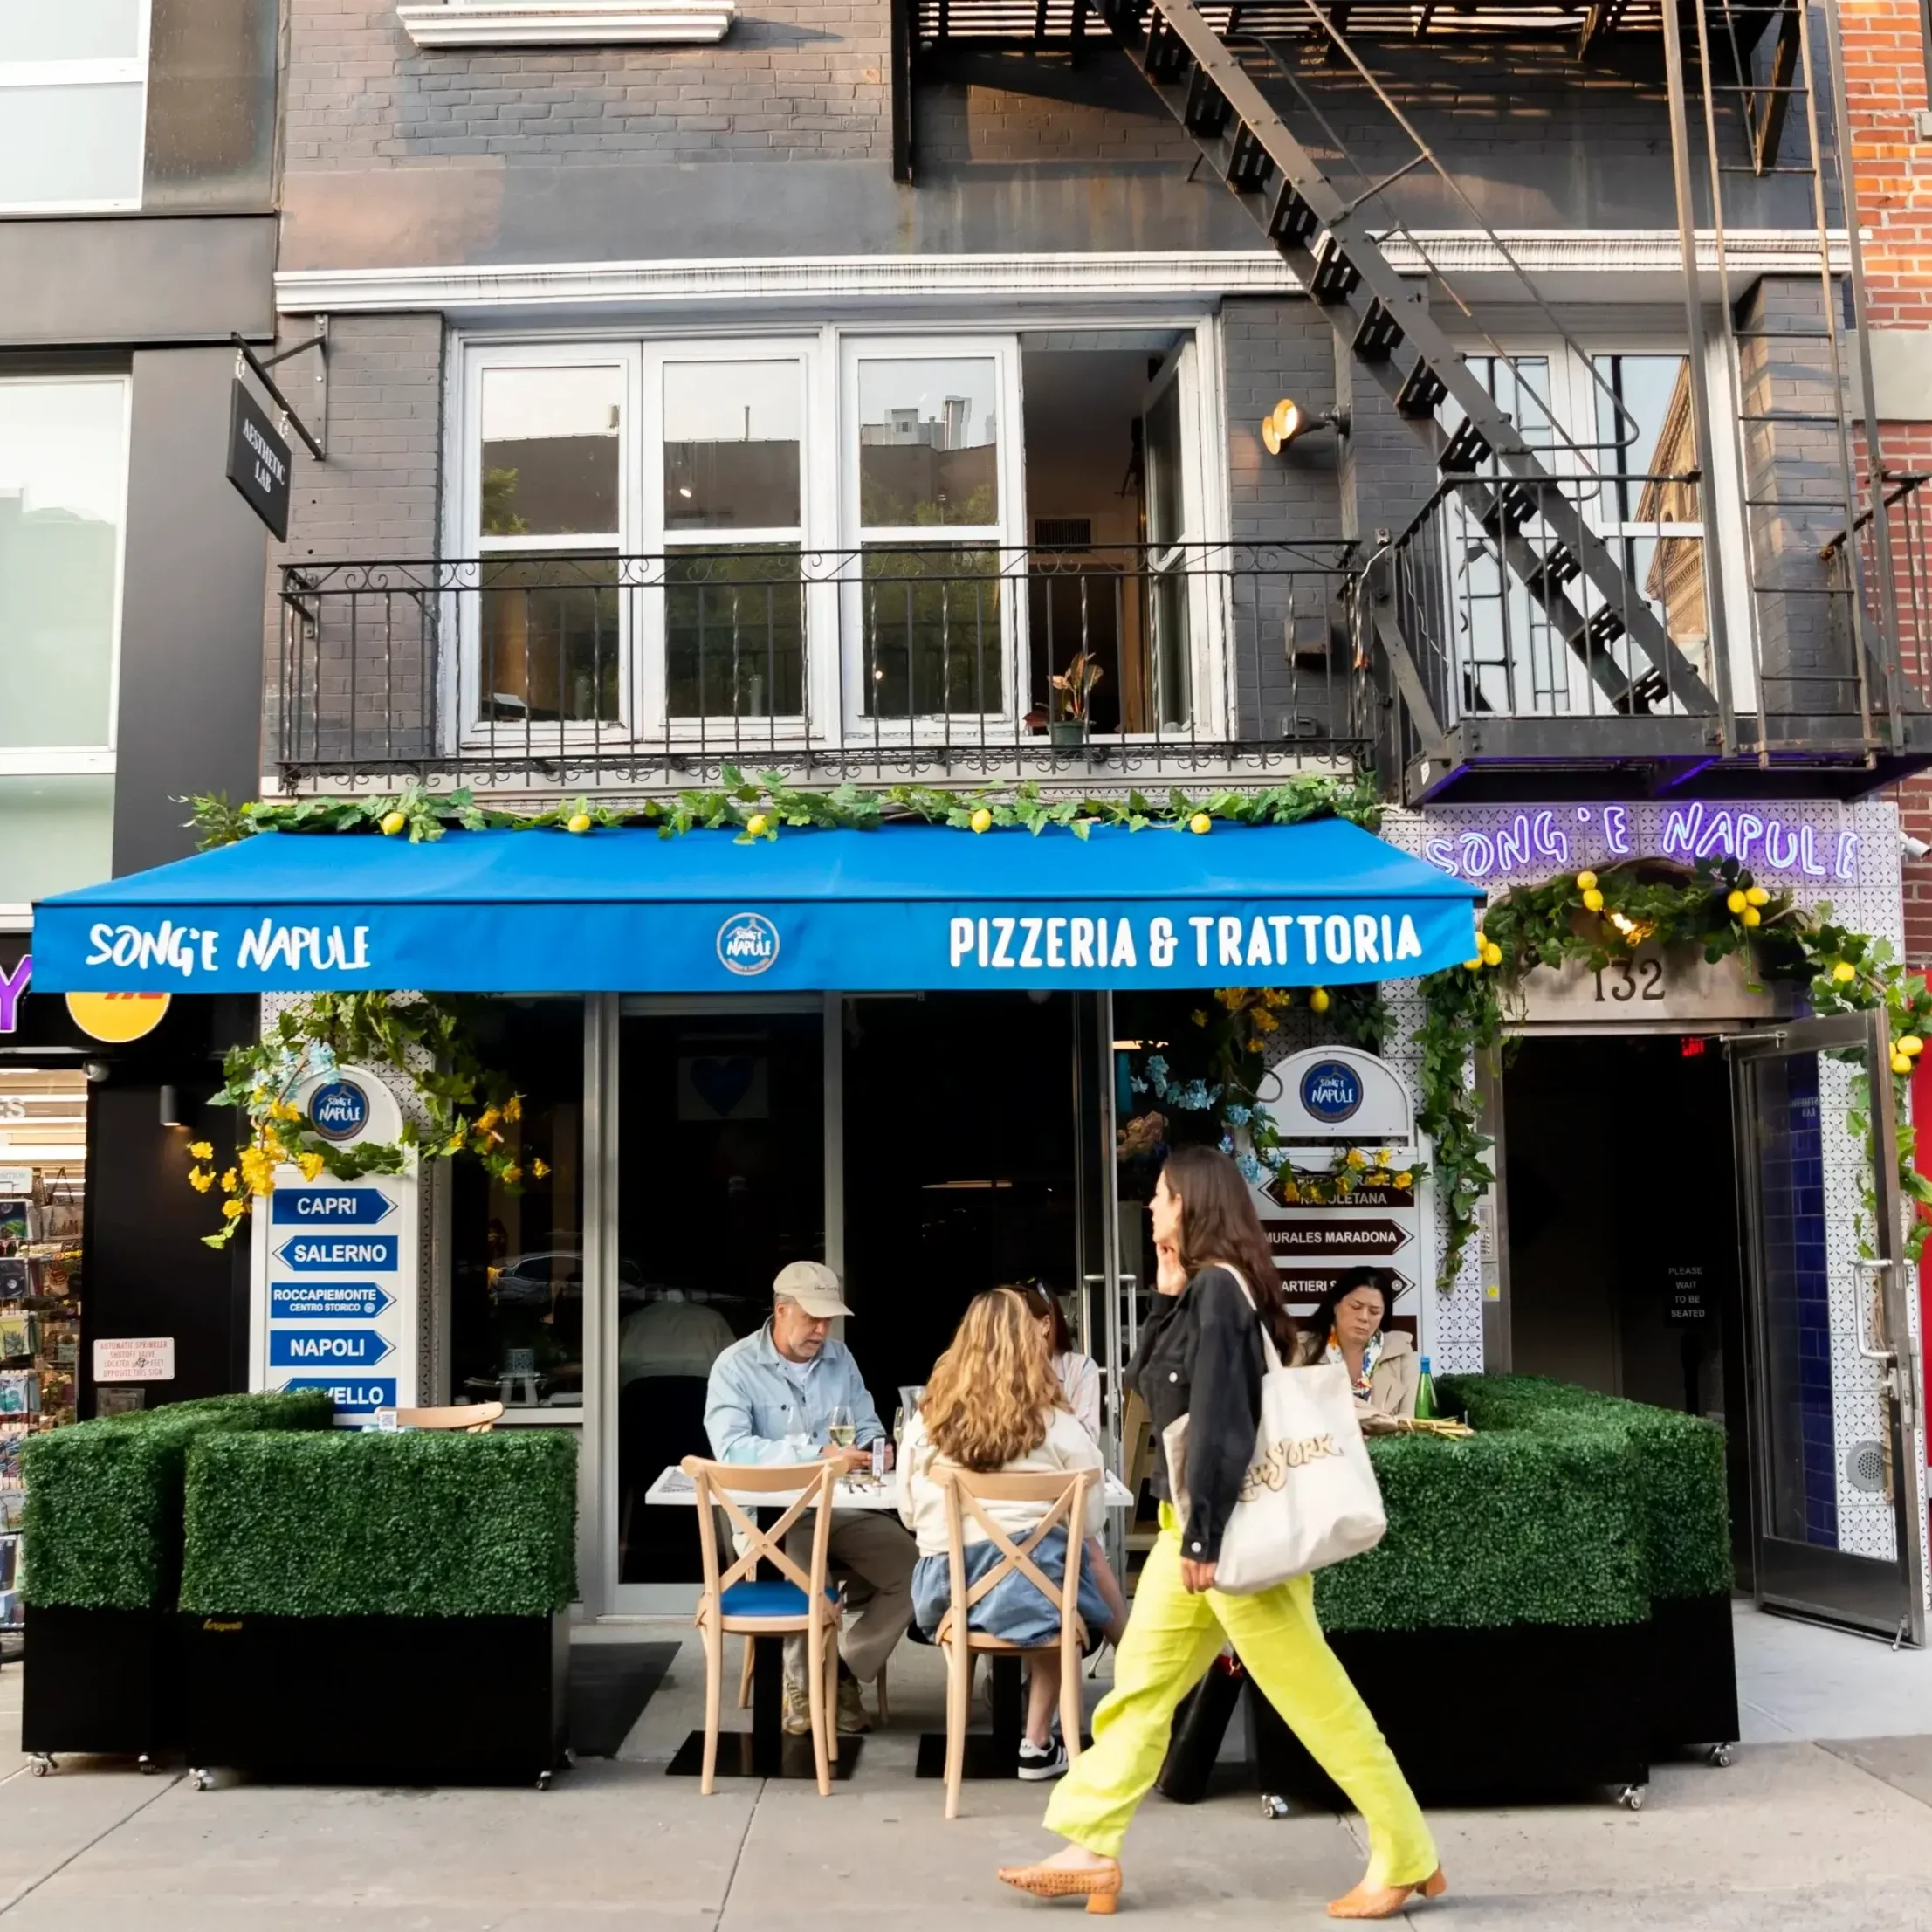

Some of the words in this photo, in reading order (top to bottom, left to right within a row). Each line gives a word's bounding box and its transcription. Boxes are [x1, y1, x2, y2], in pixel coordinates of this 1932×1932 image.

[243, 419, 285, 485] AESTHETIC
[255, 460, 271, 493] LAB
[1663, 801, 1858, 879] NAPULE
[237, 918, 371, 972] NAPULE
[950, 917, 1137, 968] PIZZERIA
[1149, 917, 1178, 968] &
[1189, 914, 1422, 967] TRATTORIA
[1594, 959, 1666, 1002] 132
[1311, 1086, 1354, 1104] NAPULE
[319, 1104, 361, 1122] NAPULE
[297, 1197, 357, 1214] CAPRI
[1265, 1231, 1322, 1243] MURALES
[1324, 1231, 1397, 1243] MARADONA
[293, 1244, 388, 1262] SALERNO
[1668, 1266, 1703, 1275] PLEASE
[1282, 1280, 1328, 1292] ARTIERI
[1675, 1281, 1697, 1289] WAIT
[273, 1289, 376, 1301] ROCCAPIEMONTE
[1674, 1295, 1686, 1303] TO
[1688, 1295, 1701, 1303] BE
[289, 1303, 323, 1312] CENTRO
[324, 1303, 361, 1312] STORICO
[1671, 1309, 1705, 1317] SEATED
[135, 1340, 168, 1349] SPRINKLER
[290, 1338, 365, 1357] NAPOLI
